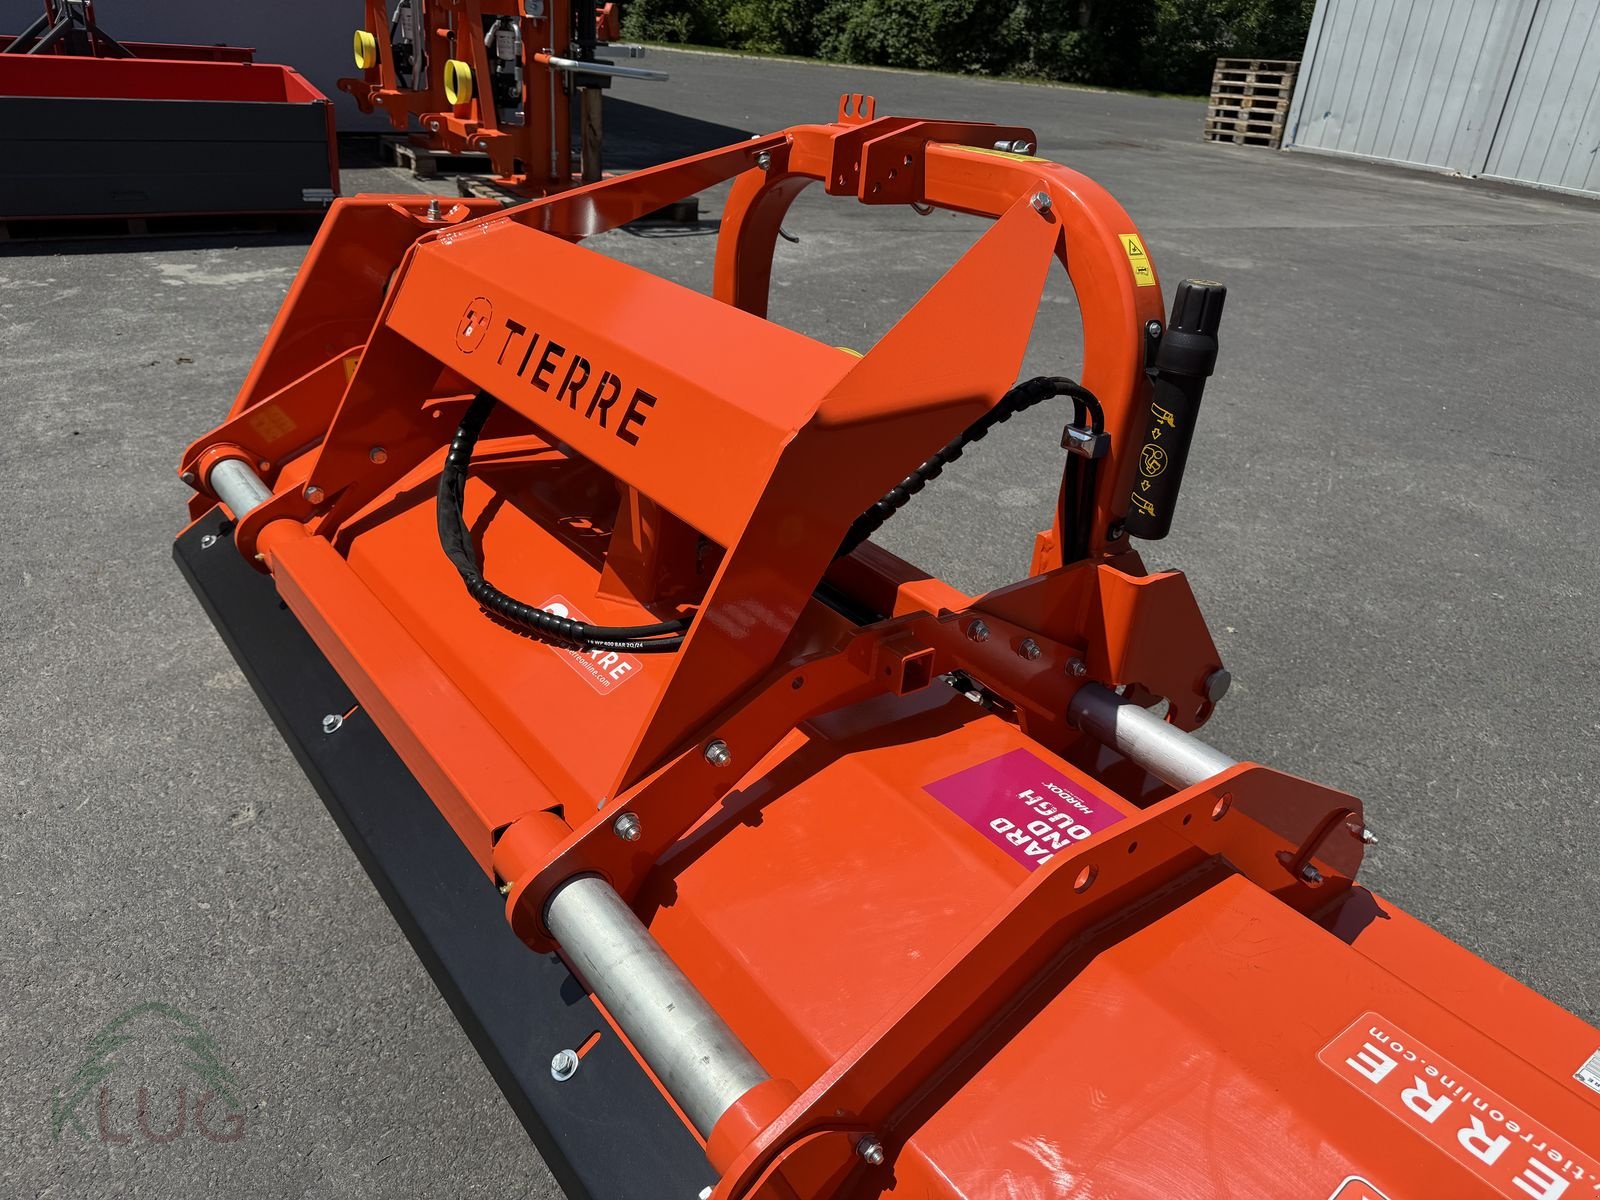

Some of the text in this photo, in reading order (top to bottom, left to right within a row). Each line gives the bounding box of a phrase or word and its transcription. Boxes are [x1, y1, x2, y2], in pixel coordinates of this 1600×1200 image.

[496, 318, 658, 447] TIERRE
[1016, 788, 1093, 840] OUGH
[1044, 782, 1094, 814] HARDOX
[1026, 820, 1074, 850] ND
